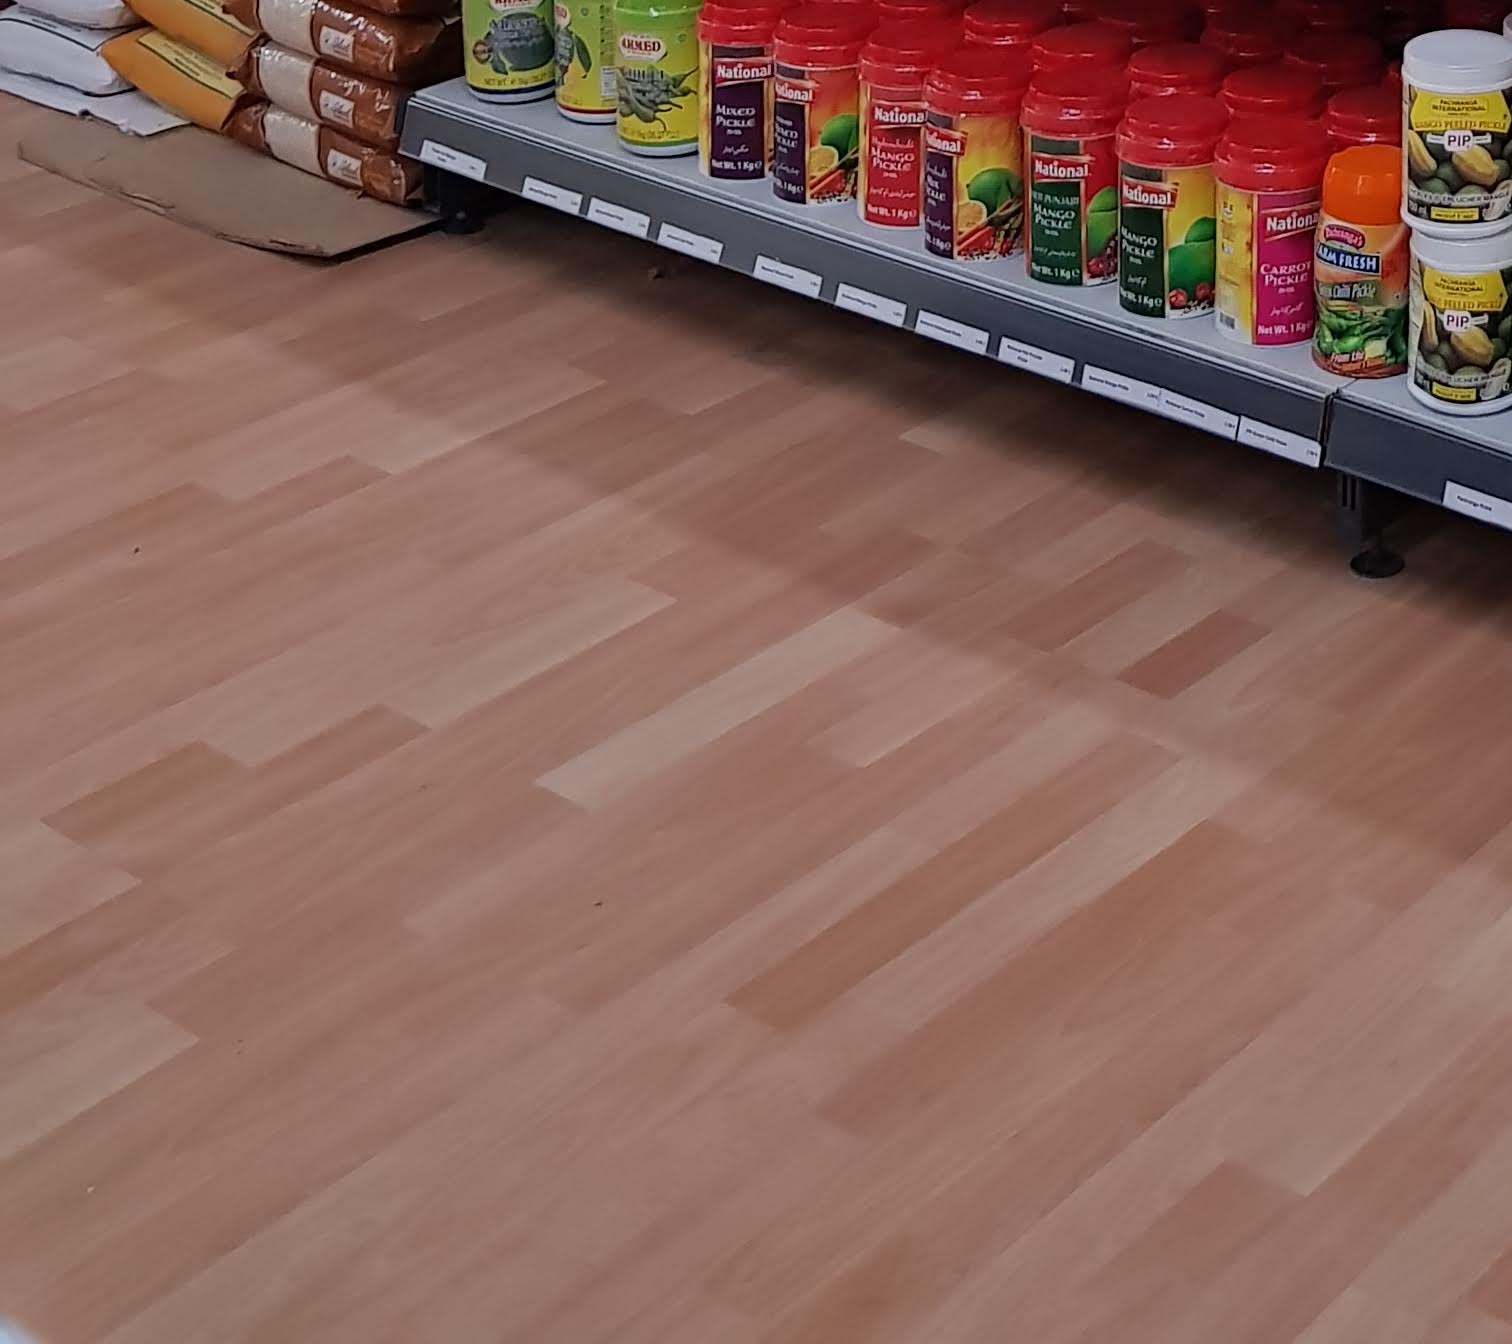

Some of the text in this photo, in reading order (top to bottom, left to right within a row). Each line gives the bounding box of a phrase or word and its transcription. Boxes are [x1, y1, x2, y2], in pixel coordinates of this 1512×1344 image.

[620, 36, 663, 57] AHMED
[716, 61, 772, 80] National
[715, 104, 756, 117] MIXED
[874, 106, 927, 124] Nationa
[715, 115, 756, 129] PICKLE
[1479, 121, 1508, 131] PICKLE
[1447, 134, 1472, 148] PIP
[871, 146, 916, 164] MANGO
[872, 158, 913, 172] PICKLE
[1034, 158, 1090, 179] National
[1122, 183, 1174, 206] National
[1033, 202, 1077, 221] MANGO
[1034, 216, 1074, 231] PICKLE
[1121, 226, 1159, 247] MANGO
[1121, 240, 1156, 259] PICKLE
[1259, 261, 1313, 278] CARROT
[1339, 251, 1379, 272] FRESH
[1264, 272, 1309, 287] PICKLE
[1350, 283, 1378, 299] Pickle
[1257, 323, 1295, 336] Net Wt. 1
[1446, 314, 1471, 328] PIP
